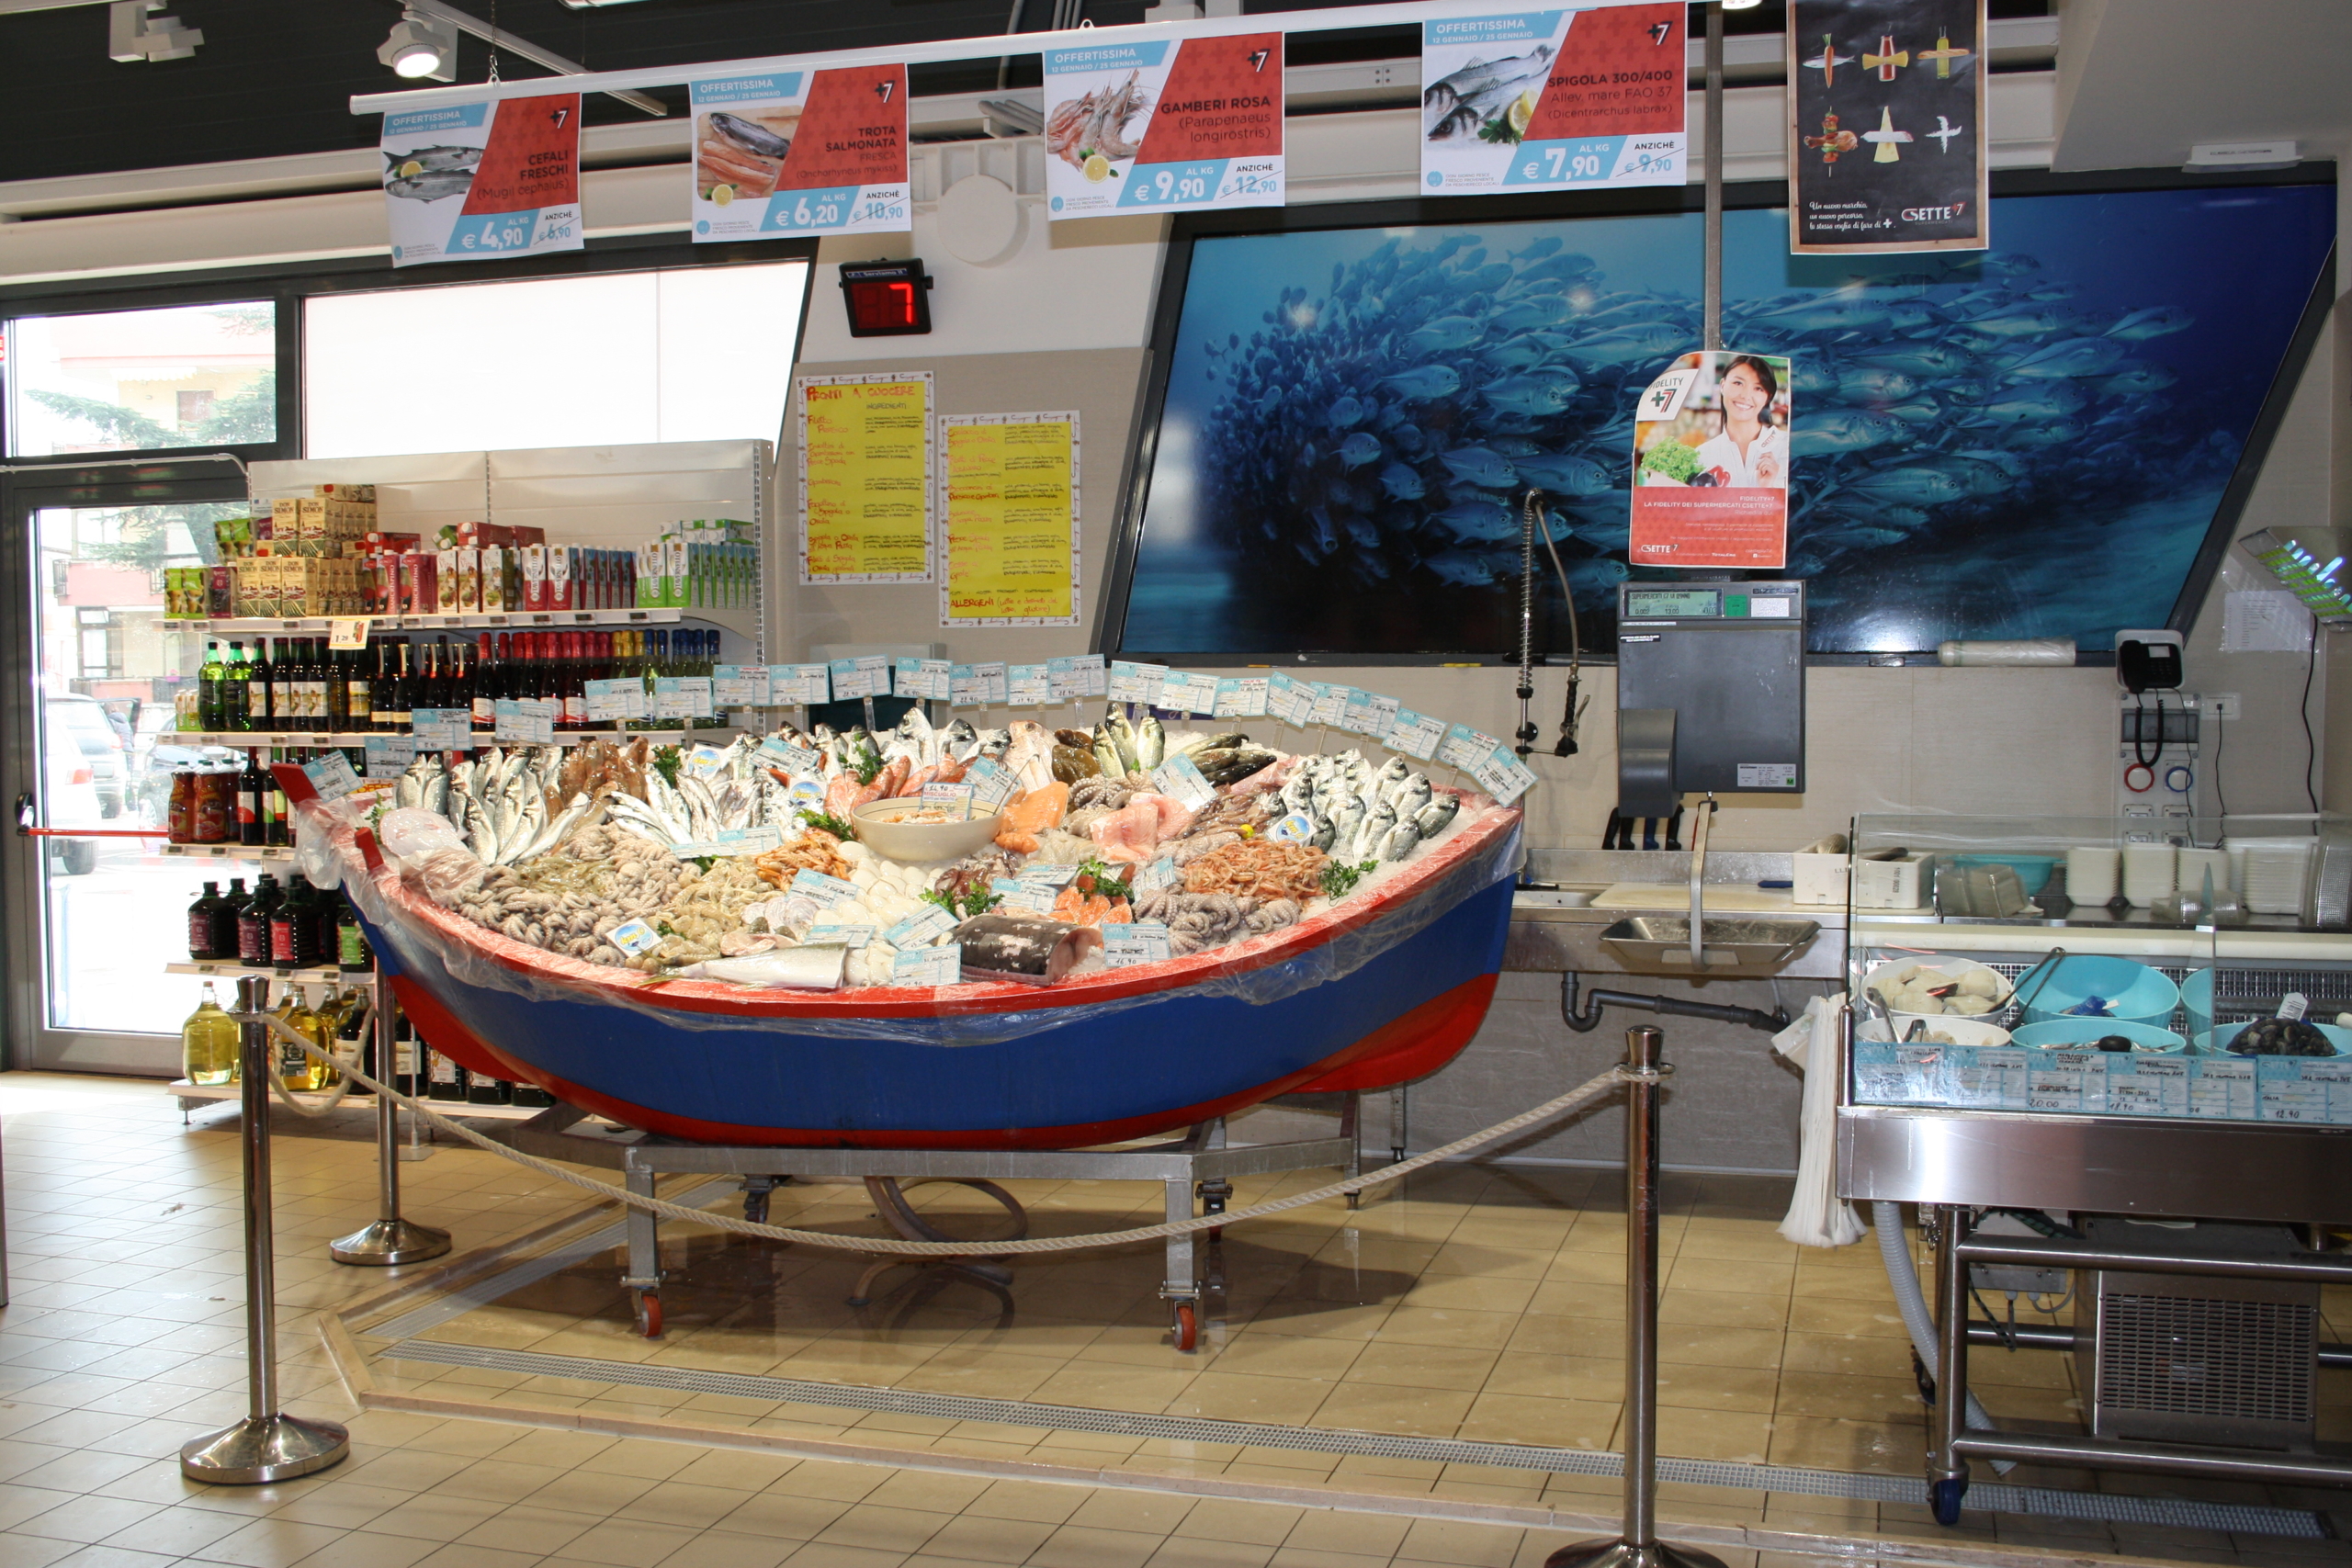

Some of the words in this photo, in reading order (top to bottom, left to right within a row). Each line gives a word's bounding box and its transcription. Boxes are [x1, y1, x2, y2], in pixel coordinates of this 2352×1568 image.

[1436, 18, 1526, 34] OFFERTISSIMA
[1442, 35, 1478, 43] GENNAIO
[1496, 31, 1533, 40] GENNAIO
[1055, 48, 1136, 63] OFFERTISSIMA
[1060, 64, 1093, 73] GENNAIO
[1110, 60, 1143, 68] GENNAIO
[700, 79, 774, 93] OFFERTISSIMA
[1548, 73, 1608, 88] SPIGOLA
[1612, 70, 1673, 84] 300/400
[751, 90, 781, 98] GENNAIO
[1588, 89, 1621, 100] mare
[1624, 87, 1654, 98] FAO
[1657, 86, 1673, 97] 37
[1160, 100, 1227, 115] GAMBERI
[1231, 96, 1271, 109] ROSA
[1547, 107, 1631, 120] (Dicentrarchus
[1633, 104, 1673, 117] labrax)
[392, 110, 461, 126] OFFERTISSIMA
[1179, 113, 1271, 130] (Parapenaeus
[396, 125, 424, 134] GENNAIO
[438, 120, 467, 129] GENNAIO
[858, 126, 897, 137] TROTA
[1190, 127, 1271, 142] longirostris)
[825, 139, 897, 152] SALMONATA
[1579, 144, 1593, 152] AL
[1595, 143, 1610, 152] KG
[1634, 141, 1675, 151] ANZICHÈ
[528, 150, 569, 165] CEFALI
[859, 152, 897, 163] FRESCA
[1545, 148, 1600, 181] 7,90
[1638, 154, 1672, 174] 9,90
[520, 164, 569, 180] FRESCHI
[865, 164, 898, 175] mykiss)
[1186, 167, 1198, 175] AL
[1201, 166, 1214, 175] KG
[1236, 164, 1273, 173] ANZICHÈ
[476, 186, 514, 200] (Mugil
[517, 178, 570, 197] cephalus)
[1155, 171, 1204, 203] 9,90
[1236, 175, 1277, 195] 12,90
[821, 194, 832, 202] AL
[834, 193, 846, 201] KG
[866, 190, 899, 198] ANZICHÈ
[545, 210, 572, 221] ANZICHÈ
[794, 197, 838, 228] 6,20
[519, 217, 529, 225] KG
[481, 221, 523, 251] 4,90
[888, 283, 912, 323] 7
